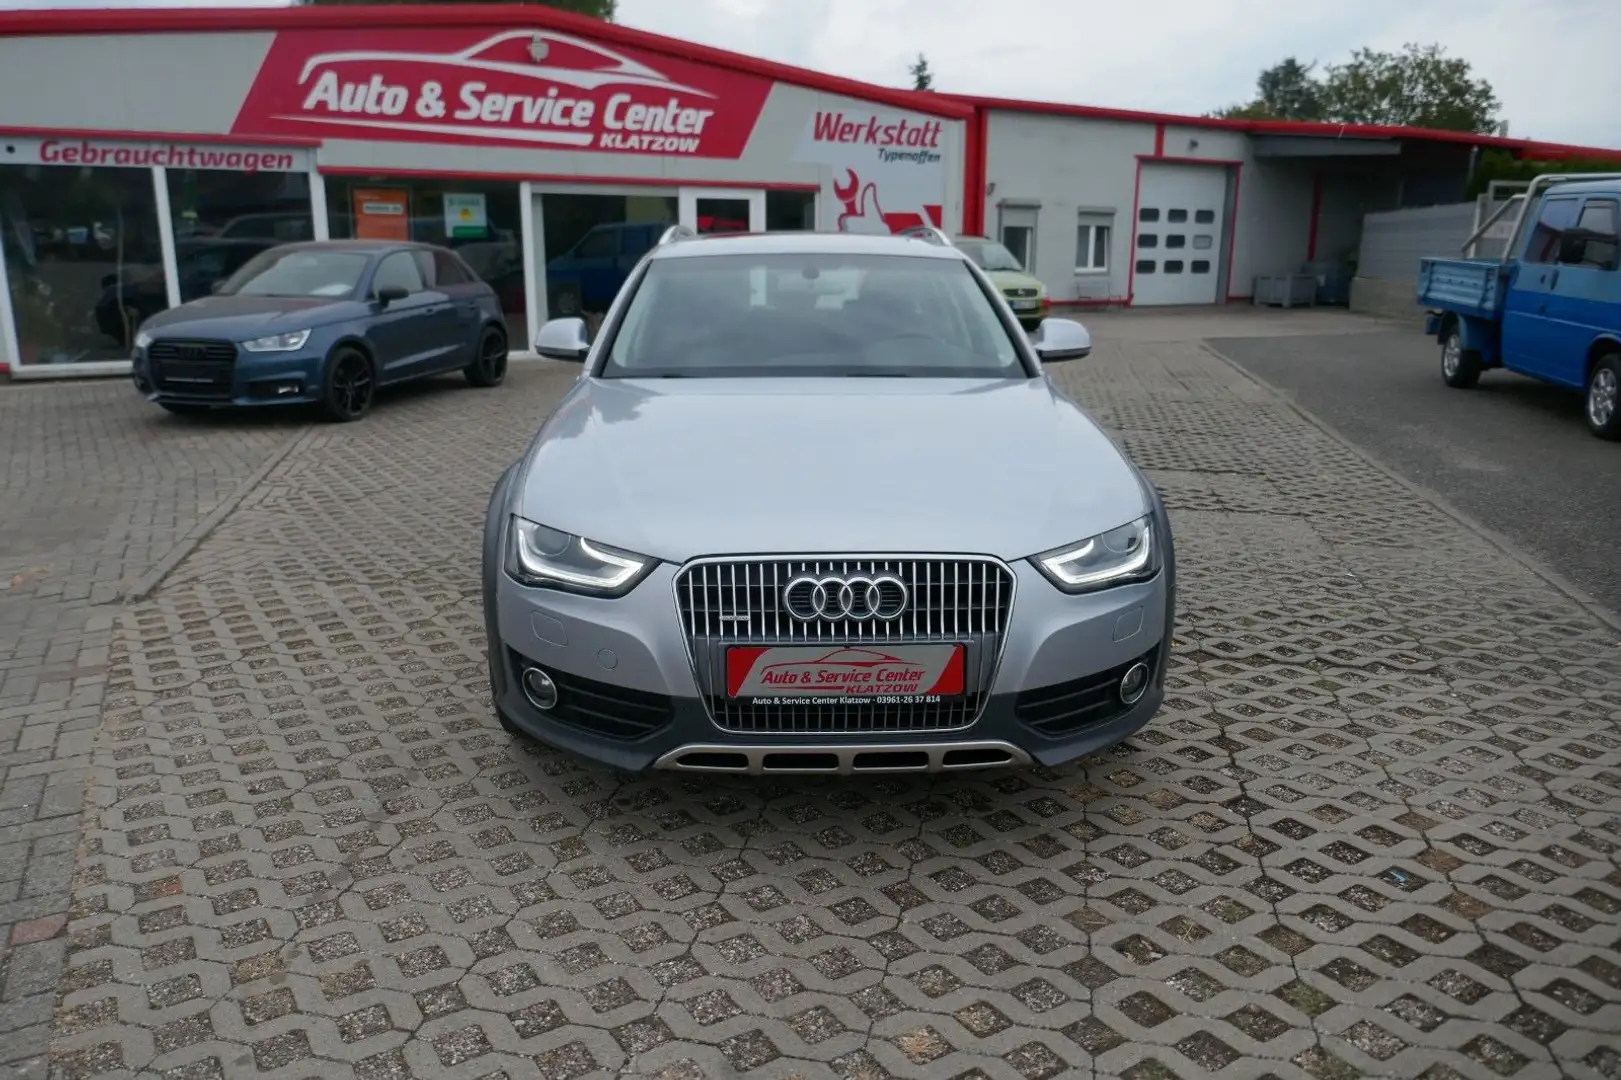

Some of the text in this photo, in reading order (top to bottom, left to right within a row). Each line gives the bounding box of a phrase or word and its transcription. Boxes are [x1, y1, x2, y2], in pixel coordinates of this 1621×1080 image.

[303, 69, 715, 135] Auto & Service Center
[813, 111, 943, 148] Werkstatt
[599, 132, 700, 153] KLATZOW
[39, 139, 294, 175] Gebrauchtwagen
[878, 148, 941, 164] Typenoffen
[760, 668, 926, 684] Auto & Service Center
[844, 684, 918, 694] KLATZOW
[752, 696, 772, 705] Auto
[773, 696, 781, 705] &
[781, 696, 810, 705] Service
[811, 696, 838, 704] Center
[839, 696, 871, 704] Klatzow
[877, 695, 914, 704] 03961-26
[914, 695, 924, 704] 37
[925, 695, 941, 703] 814
